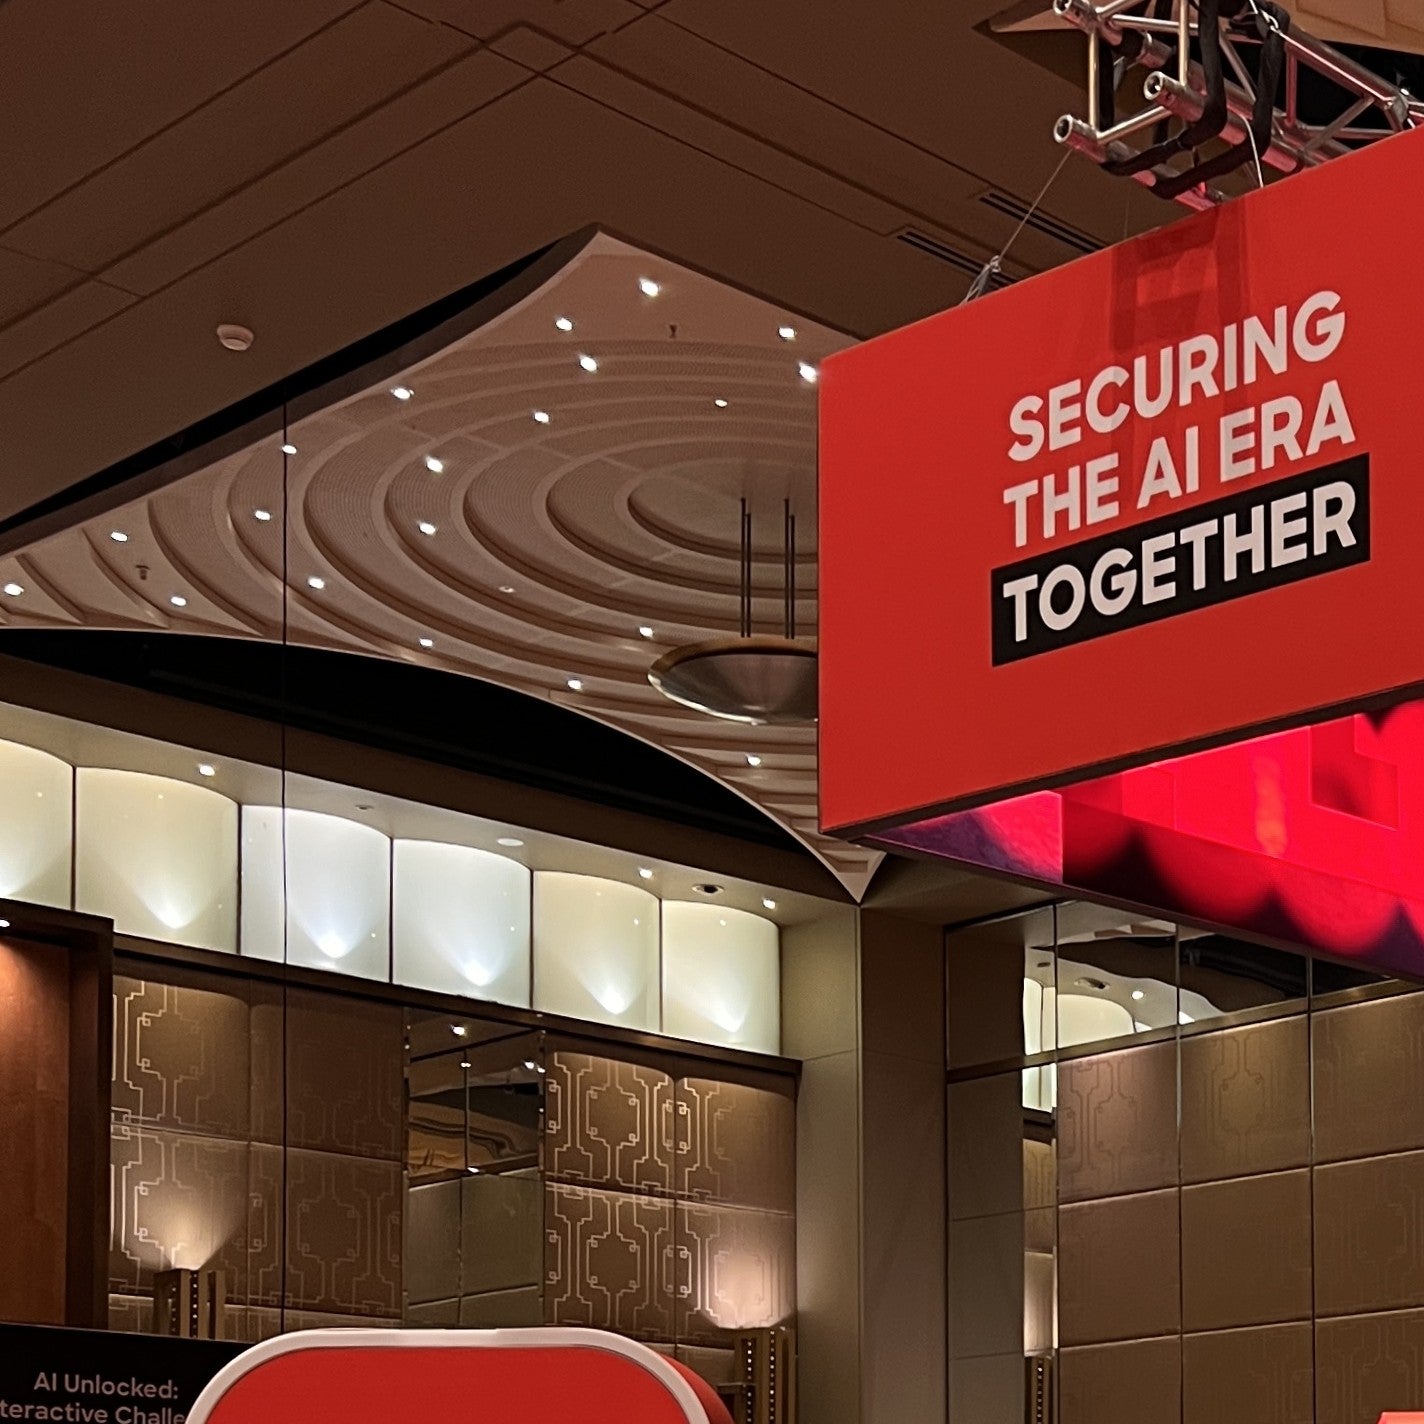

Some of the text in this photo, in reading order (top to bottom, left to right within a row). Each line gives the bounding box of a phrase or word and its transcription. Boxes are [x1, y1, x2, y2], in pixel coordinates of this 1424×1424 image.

[1008, 291, 1345, 461] SECURING
[1003, 380, 1355, 547] THE AI ERA
[1003, 481, 1357, 642] TOGETHER
[34, 1372, 178, 1399] AI Unlocked:
